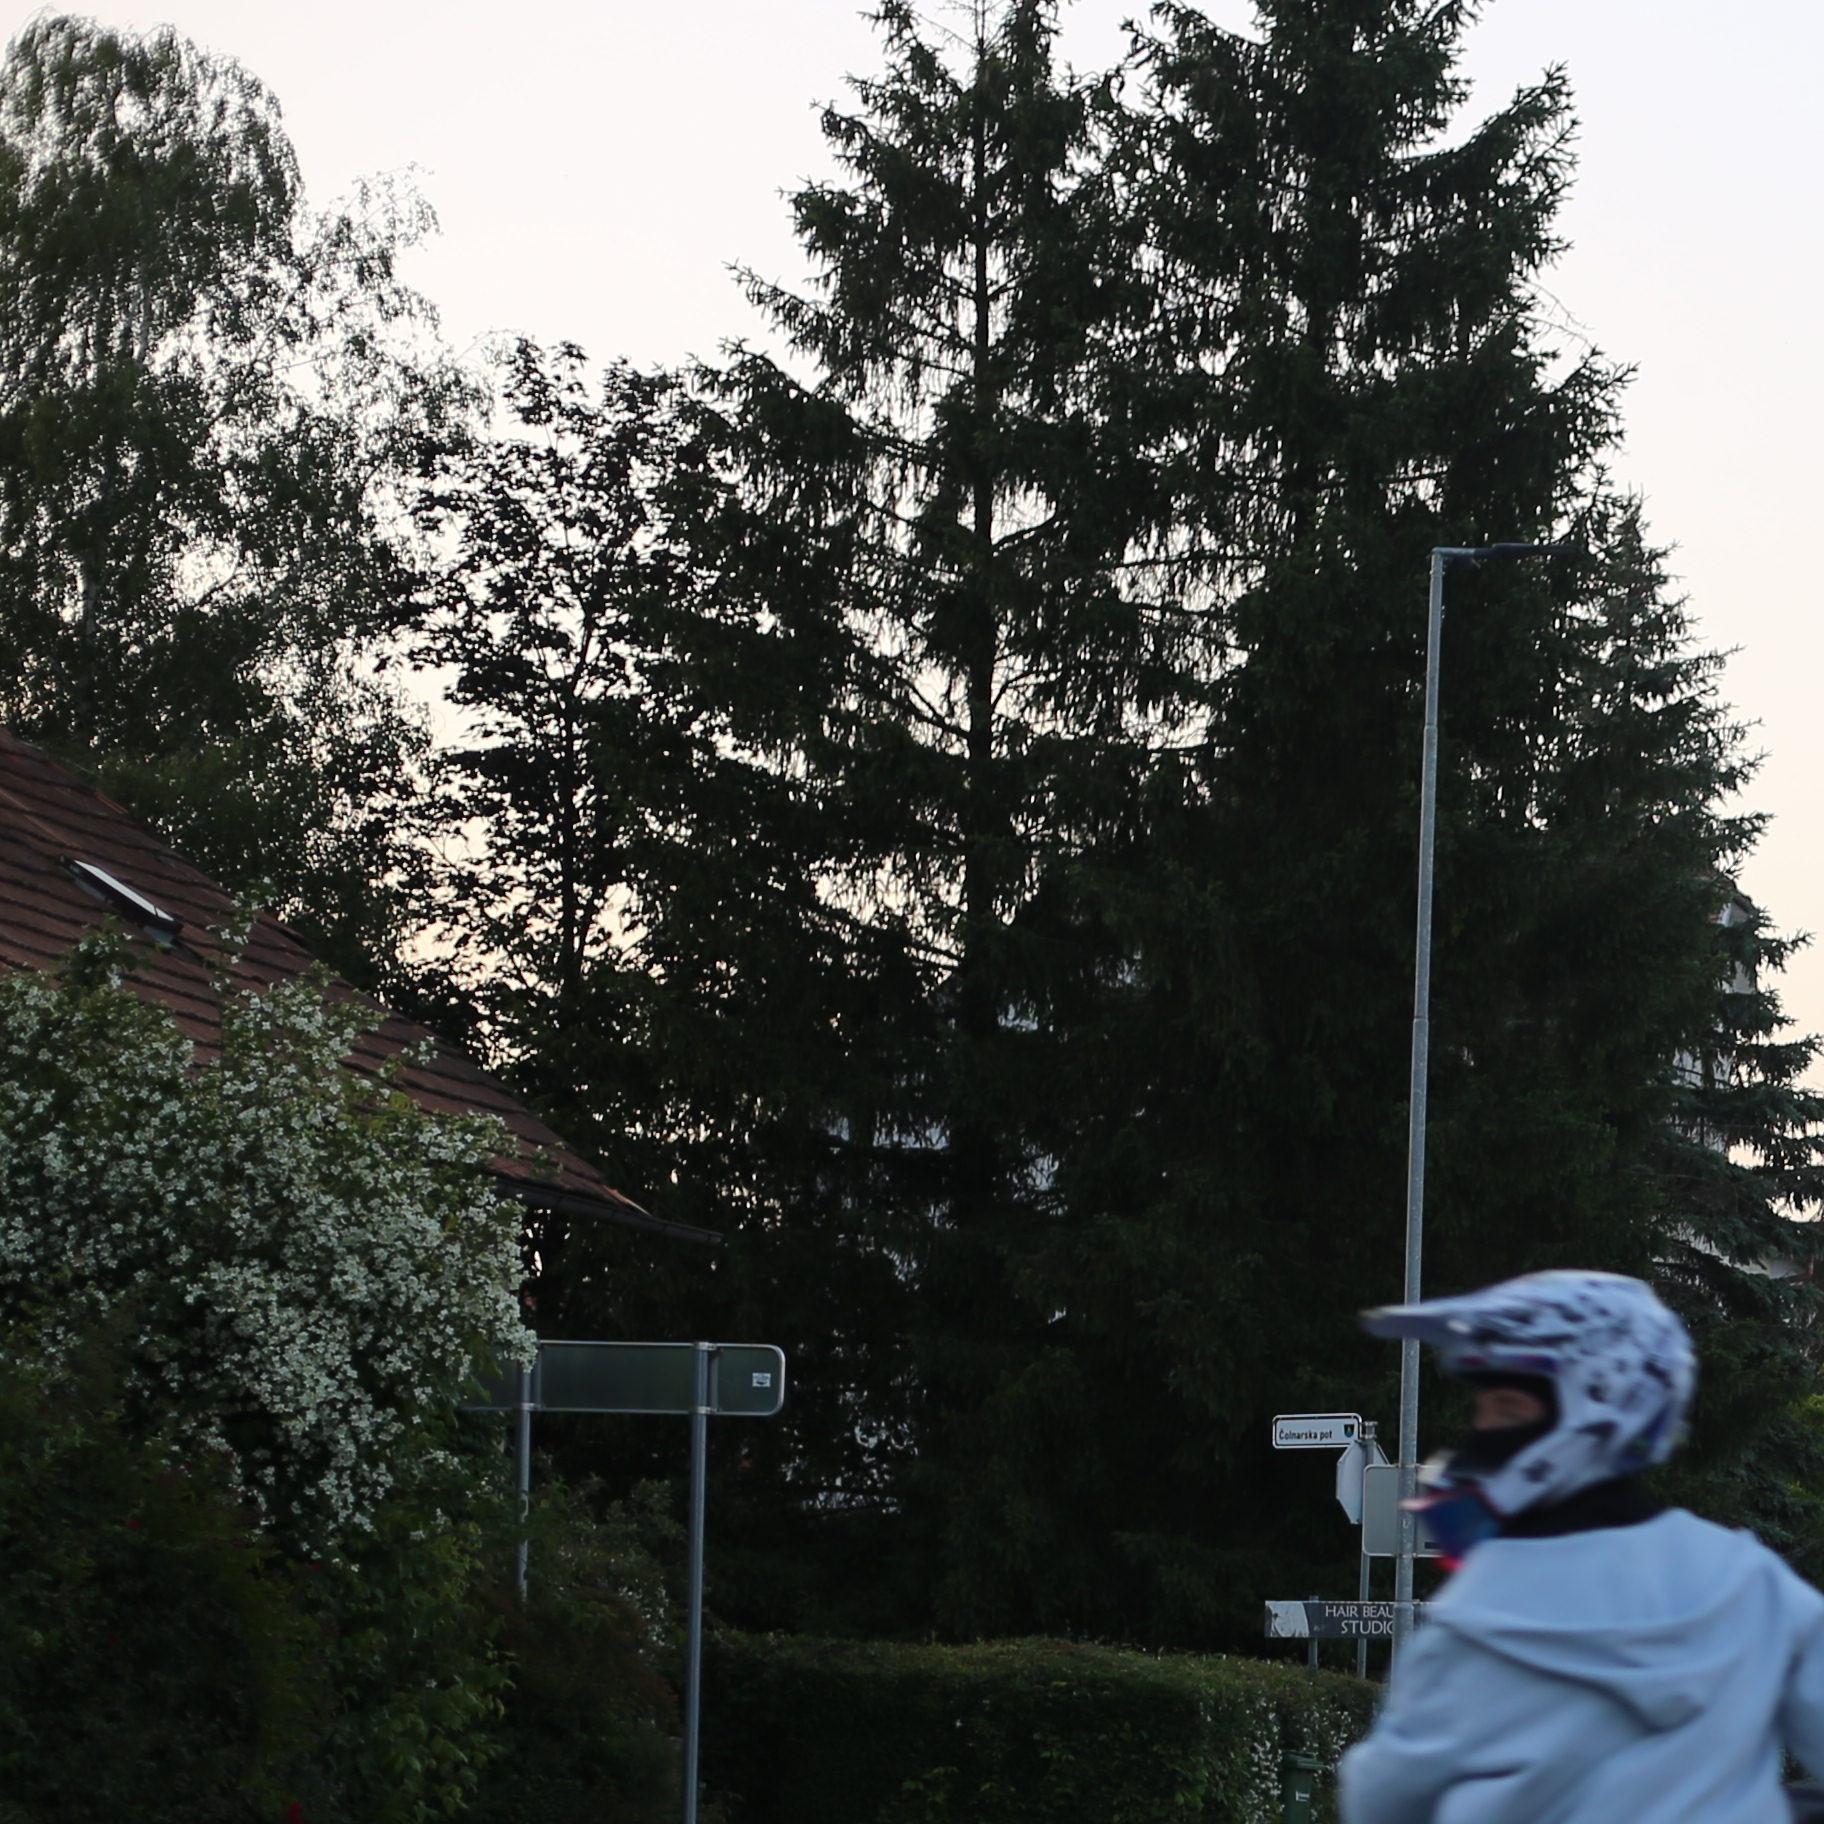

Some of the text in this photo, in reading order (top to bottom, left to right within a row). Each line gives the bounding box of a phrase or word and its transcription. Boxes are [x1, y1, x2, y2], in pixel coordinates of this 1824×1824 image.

[1320, 1430, 1333, 1441] pot
[1325, 1605, 1395, 1618] HAIR BEAU
